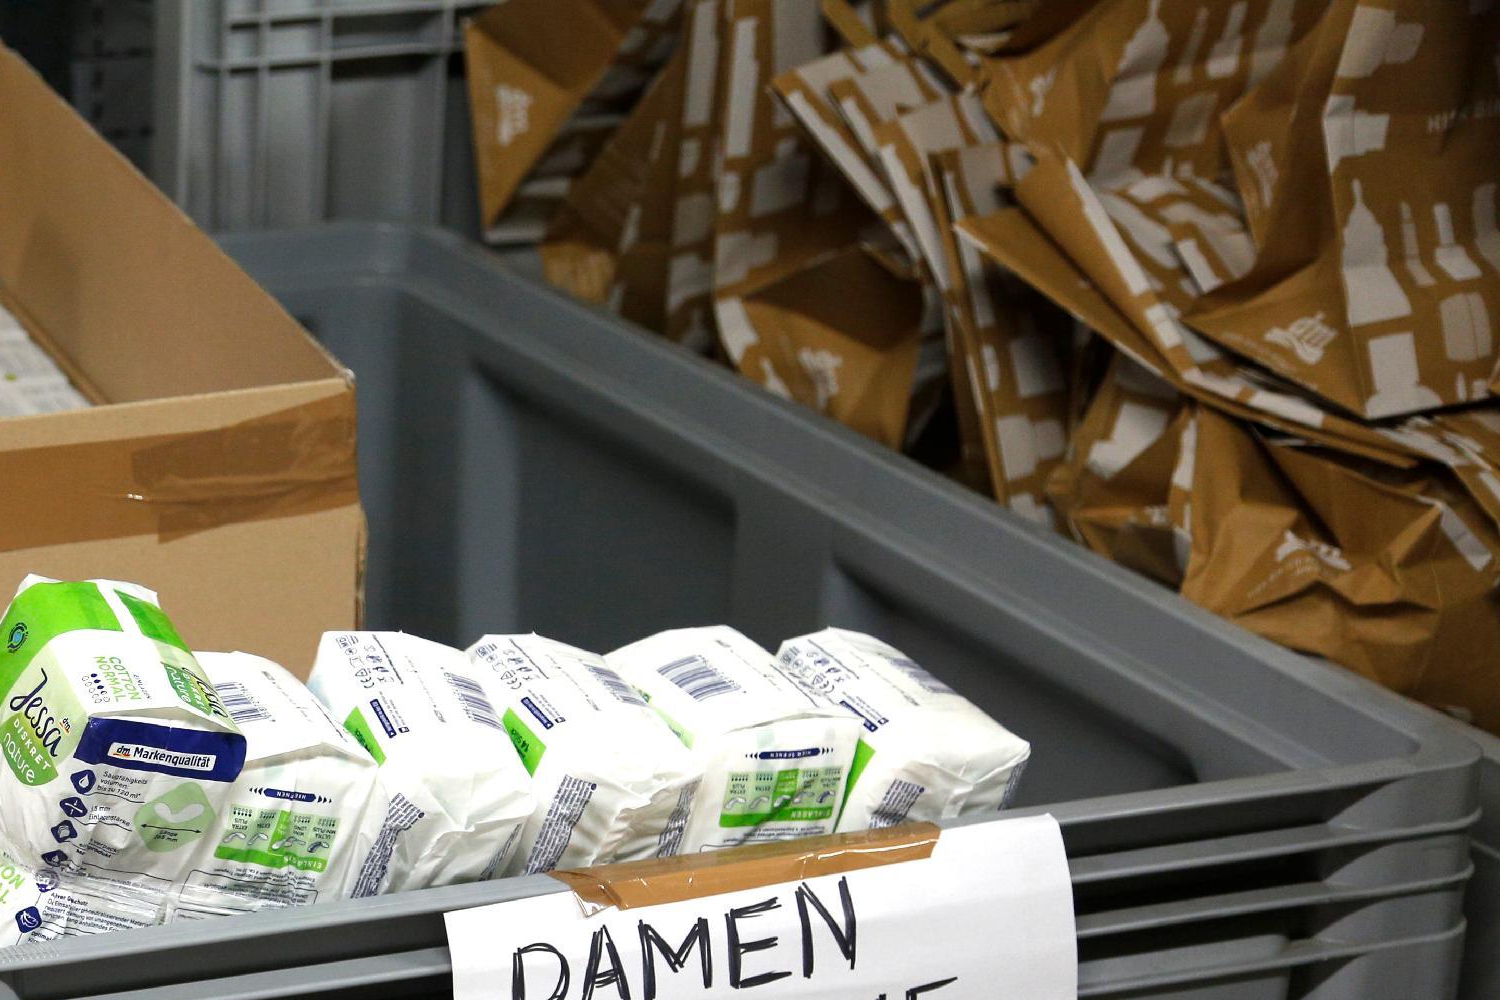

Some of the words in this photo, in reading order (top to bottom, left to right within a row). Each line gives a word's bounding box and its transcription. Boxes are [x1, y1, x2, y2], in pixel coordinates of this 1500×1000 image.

[93, 656, 127, 702] NORMAL
[108, 656, 142, 701] COTTON
[9, 667, 62, 757] Jessa
[3, 732, 36, 783] nature
[13, 717, 51, 770] DISKRET
[116, 745, 131, 755] dm
[133, 746, 211, 769] Markenqualität
